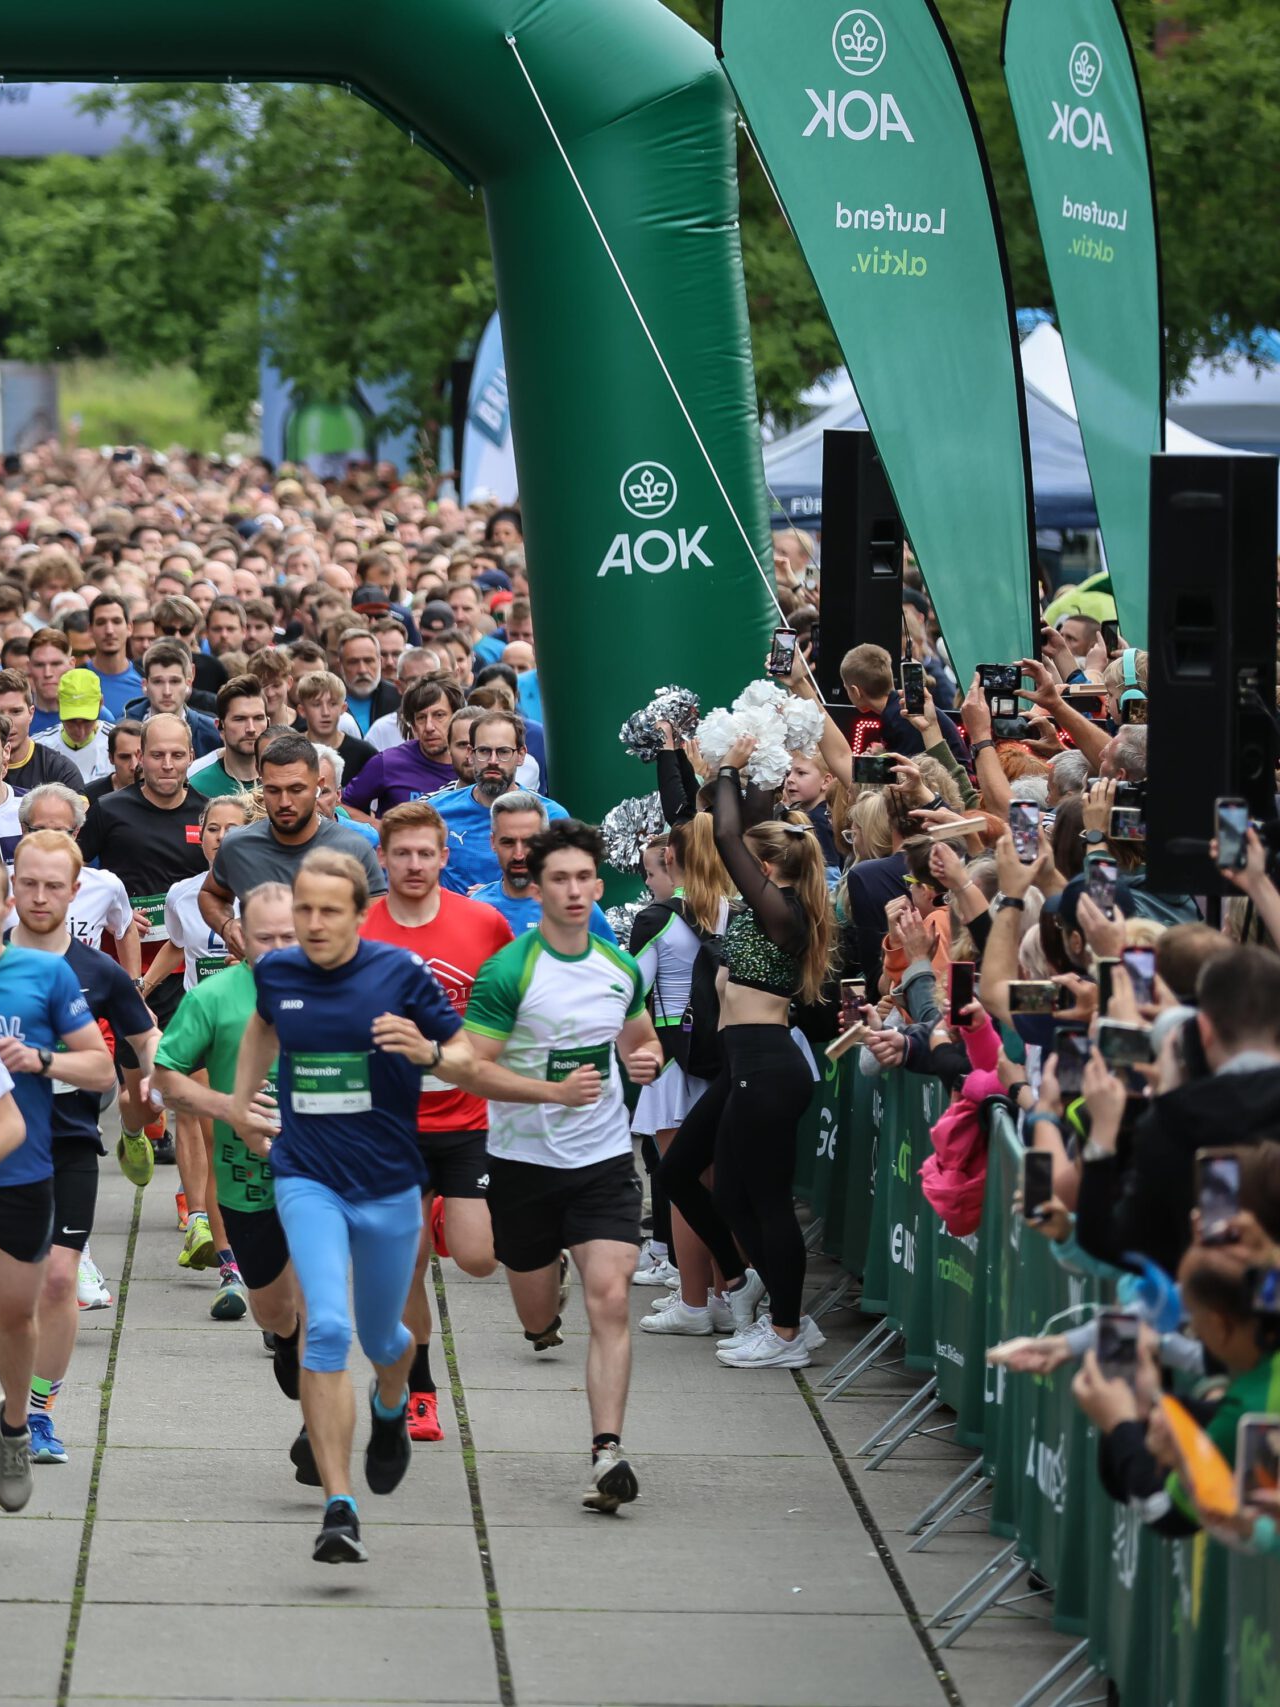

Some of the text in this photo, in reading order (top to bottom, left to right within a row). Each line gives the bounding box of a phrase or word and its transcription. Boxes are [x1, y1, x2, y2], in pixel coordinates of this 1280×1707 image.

[596, 524, 715, 576] AOK
[294, 1065, 342, 1077] Alexander
[553, 1060, 580, 1070] Robin
